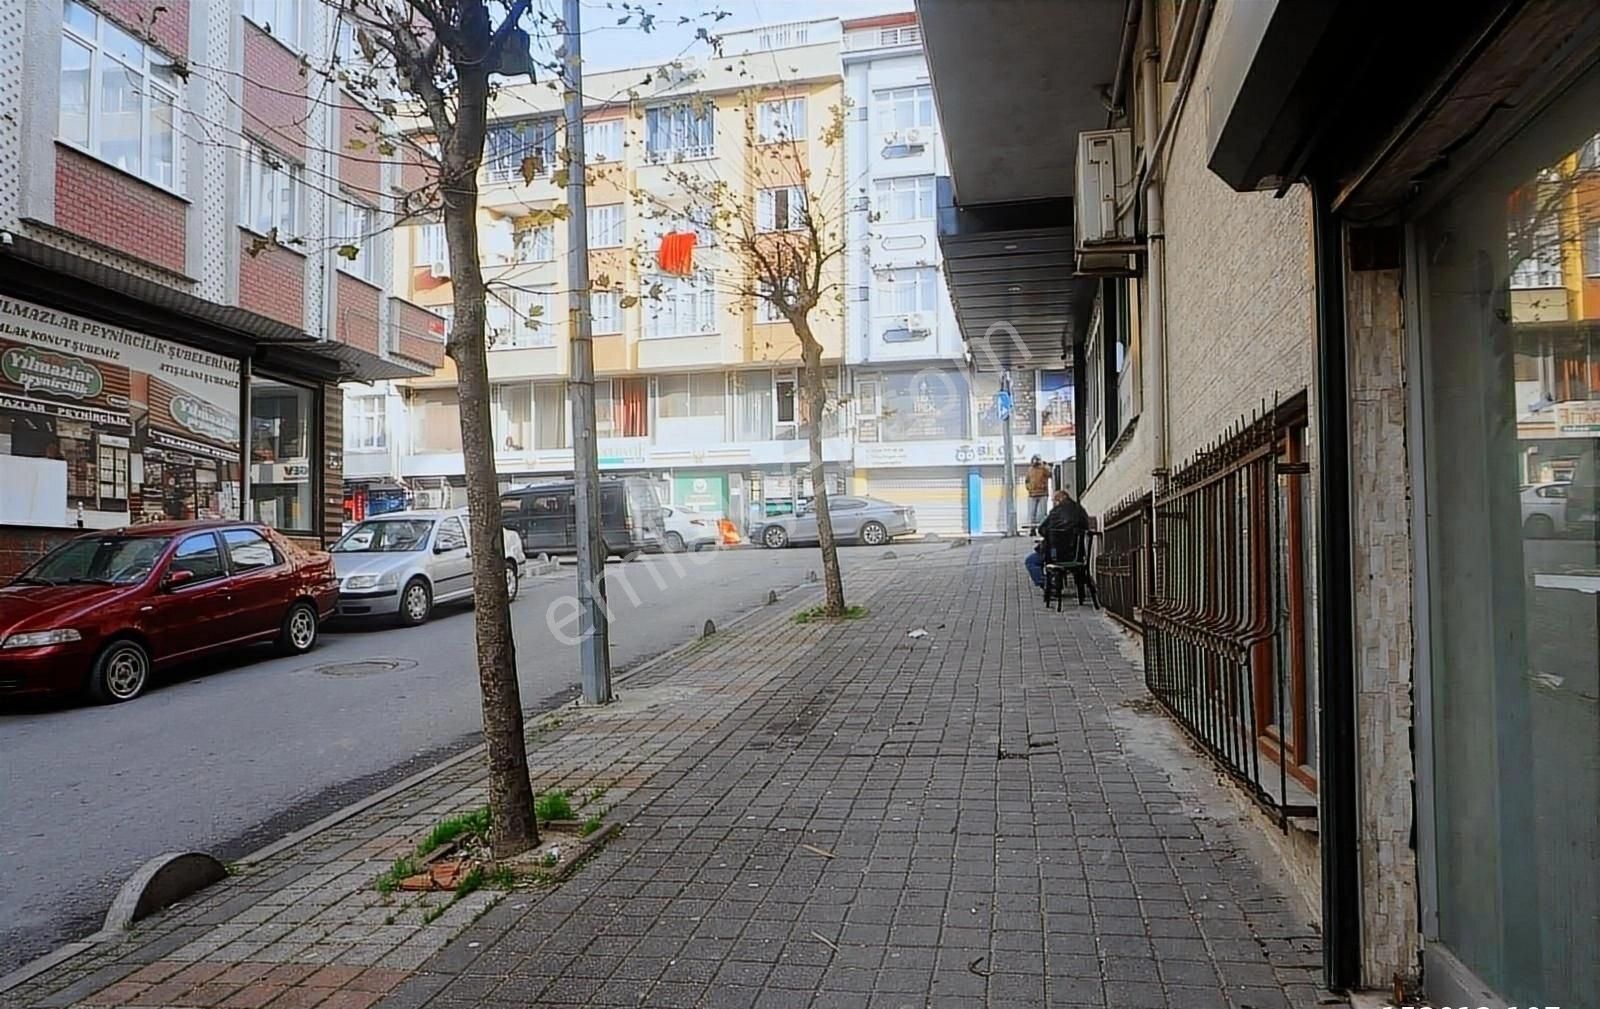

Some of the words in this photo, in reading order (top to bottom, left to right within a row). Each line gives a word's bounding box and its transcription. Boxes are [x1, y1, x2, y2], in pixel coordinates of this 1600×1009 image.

[31, 330, 71, 347] KONUT
[81, 321, 167, 355] PEYNİRCİLİK
[10, 352, 94, 383] Yılmazlar
[18, 373, 89, 394] peynircilik
